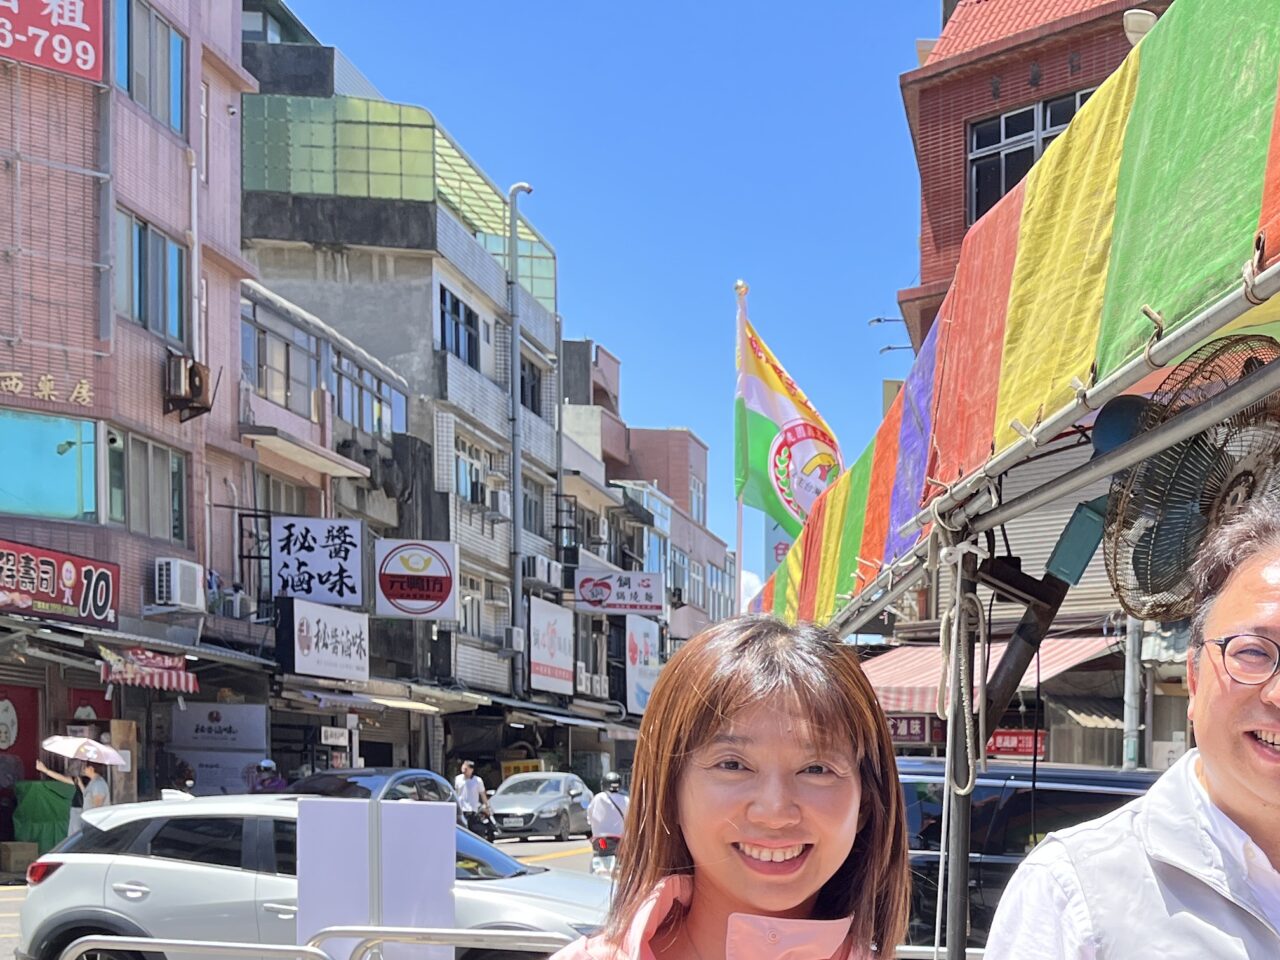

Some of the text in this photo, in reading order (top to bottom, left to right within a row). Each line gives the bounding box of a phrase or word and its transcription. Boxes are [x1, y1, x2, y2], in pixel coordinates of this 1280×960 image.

[278, 523, 358, 562] 秘醬
[80, 565, 112, 620] 10
[277, 557, 357, 597] 滷味
